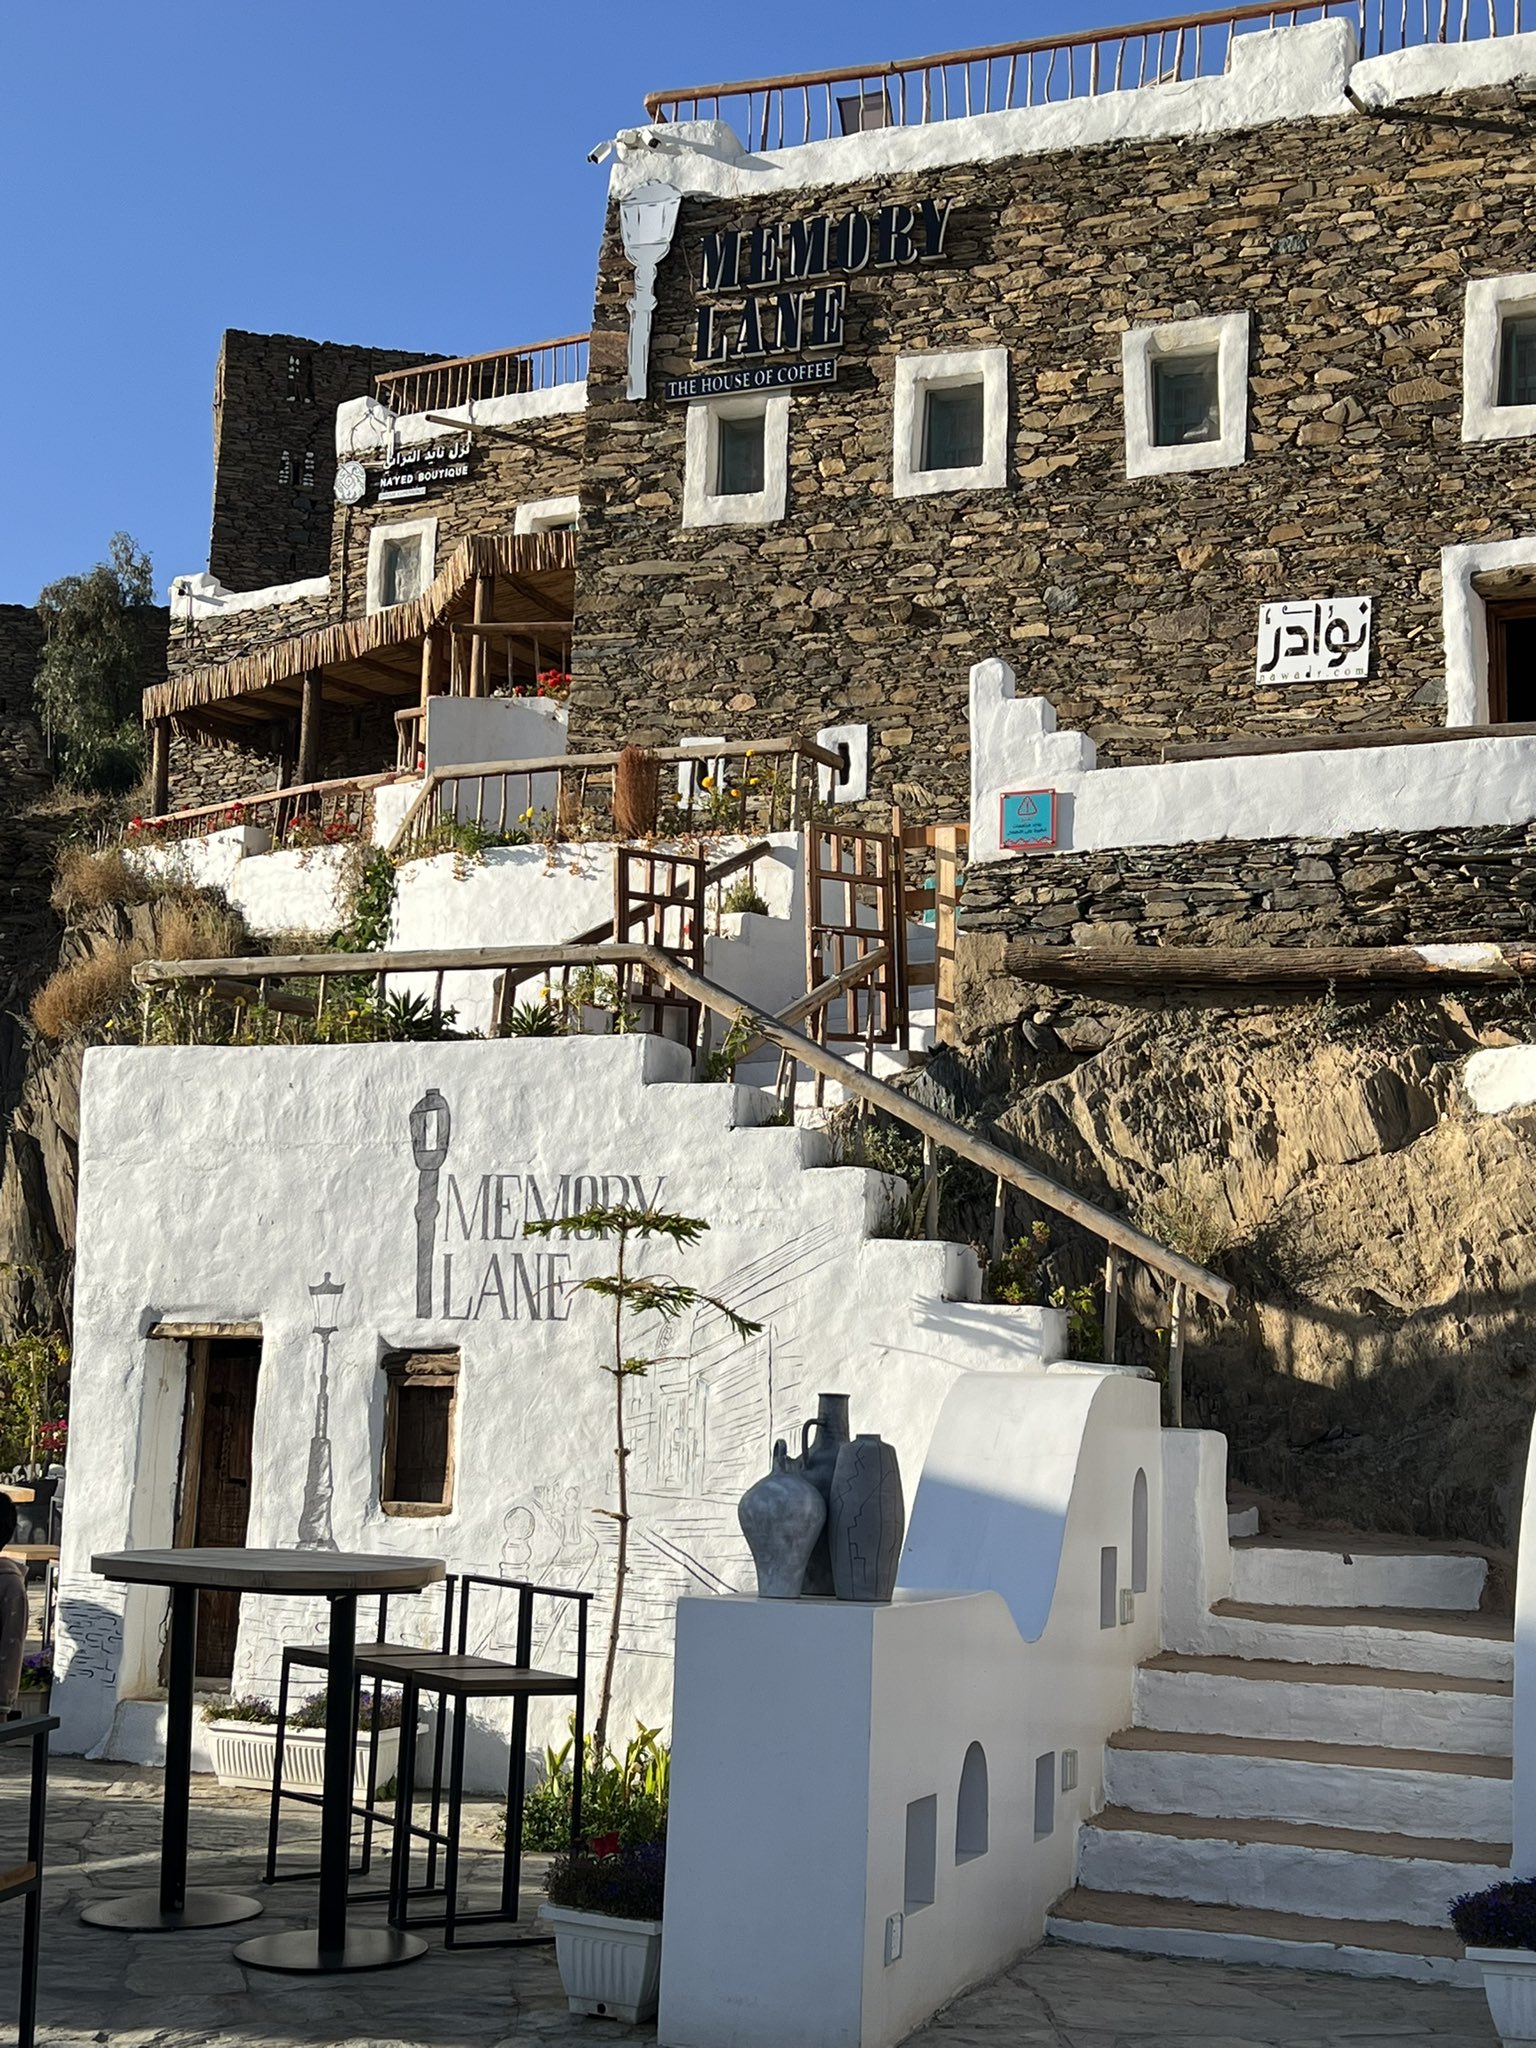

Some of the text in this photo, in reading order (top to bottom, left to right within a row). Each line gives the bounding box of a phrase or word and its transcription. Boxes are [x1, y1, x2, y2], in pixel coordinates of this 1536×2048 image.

[696, 198, 951, 295] MEMORY
[692, 282, 847, 365] LANE
[668, 359, 833, 398] THE HOUSE OF COFFEE
[380, 466, 468, 488] NAYED BOUTIQUE
[440, 1252, 573, 1321] LANE
